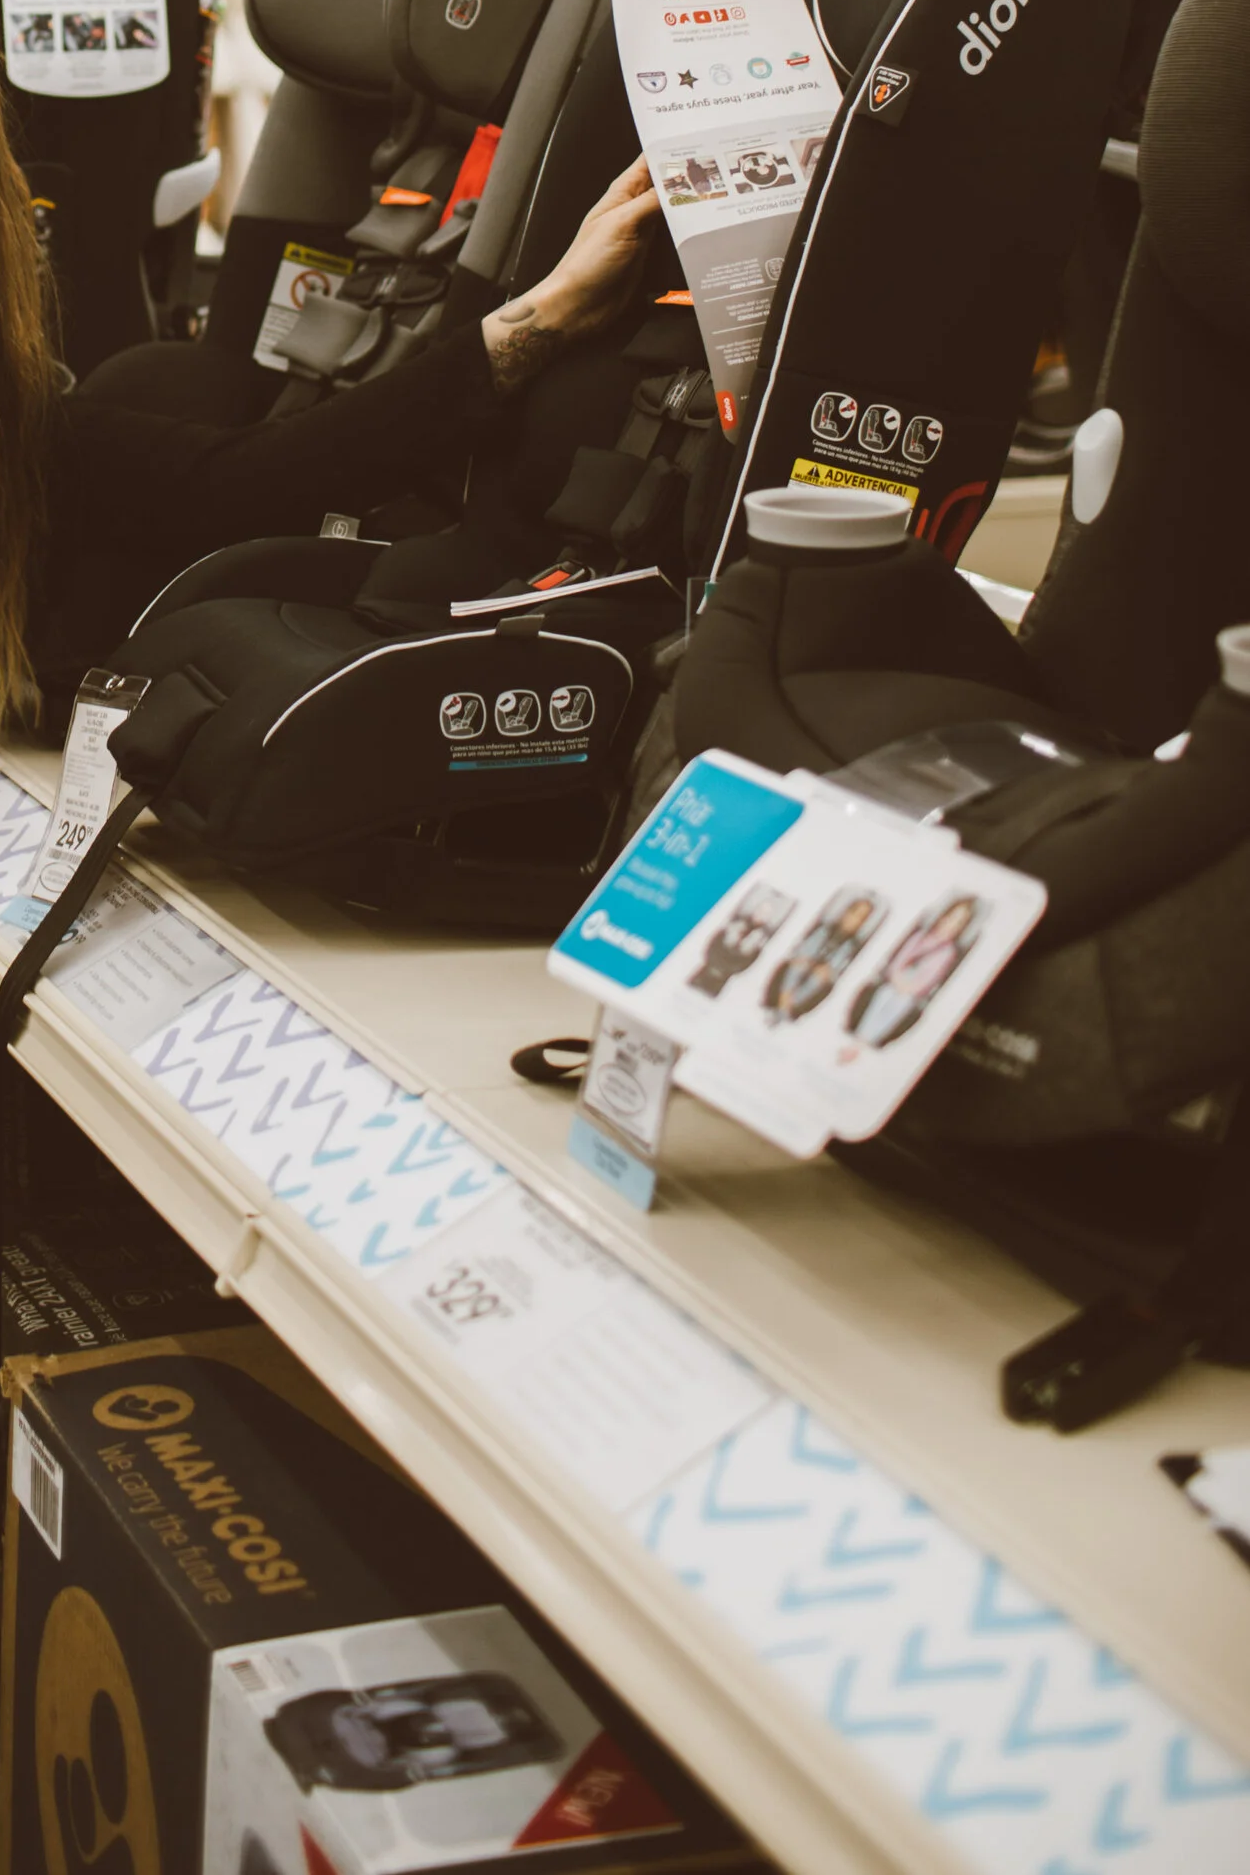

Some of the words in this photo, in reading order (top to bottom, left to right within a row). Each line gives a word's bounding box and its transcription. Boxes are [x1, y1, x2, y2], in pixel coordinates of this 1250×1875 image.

[771, 84, 795, 97] after
[796, 80, 822, 92] Year
[687, 96, 711, 110] guys
[713, 93, 742, 105] these
[723, 397, 734, 422] diono
[794, 472, 820, 485] MUERTE
[824, 468, 908, 498] ADVERTENCIA!
[450, 743, 485, 752] Conectores
[486, 742, 516, 751] inferiores
[452, 751, 468, 760] para
[492, 750, 505, 758] que
[645, 816, 711, 869] 3-in-1
[426, 1266, 500, 1324] 329
[52, 1306, 99, 1347] rainier
[97, 1440, 133, 1473] We
[117, 1471, 167, 1514] carry
[149, 1513, 189, 1548] the
[172, 1545, 233, 1606] future
